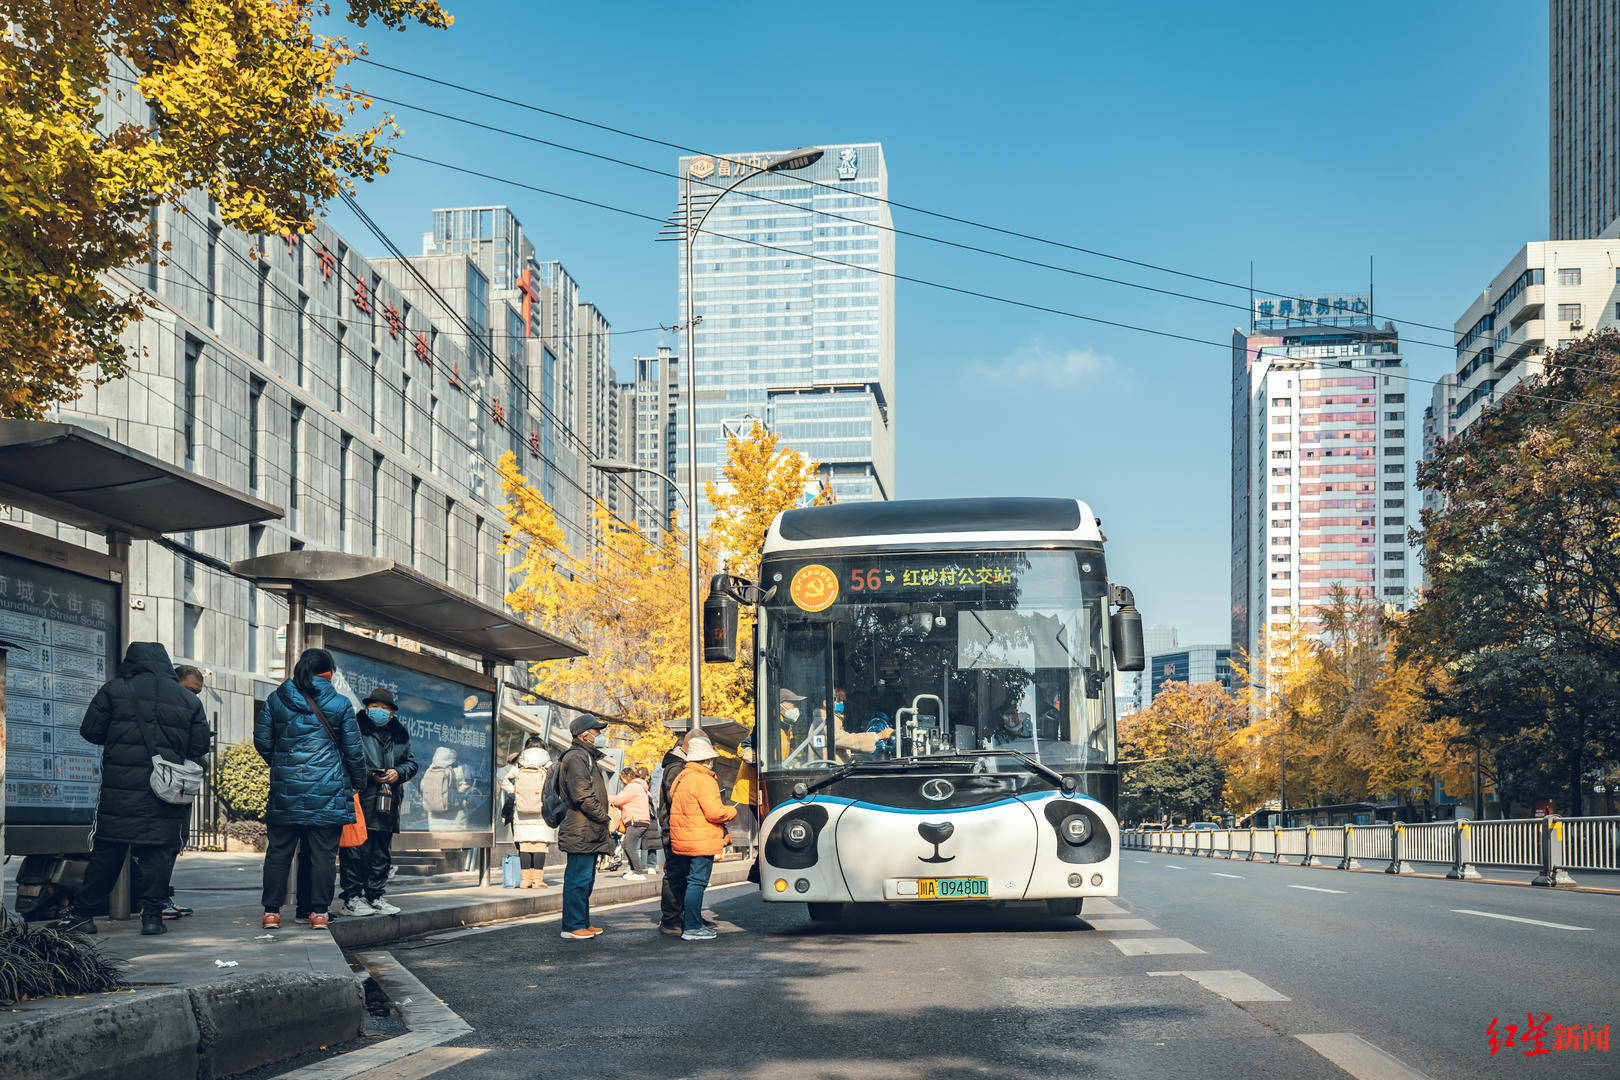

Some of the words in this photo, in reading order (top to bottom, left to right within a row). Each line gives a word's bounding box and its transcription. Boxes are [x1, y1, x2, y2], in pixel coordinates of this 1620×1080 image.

[1258, 297, 1367, 318] 世界贸易中心
[850, 568, 882, 591] 56
[903, 566, 1011, 586] 红砂村公交站
